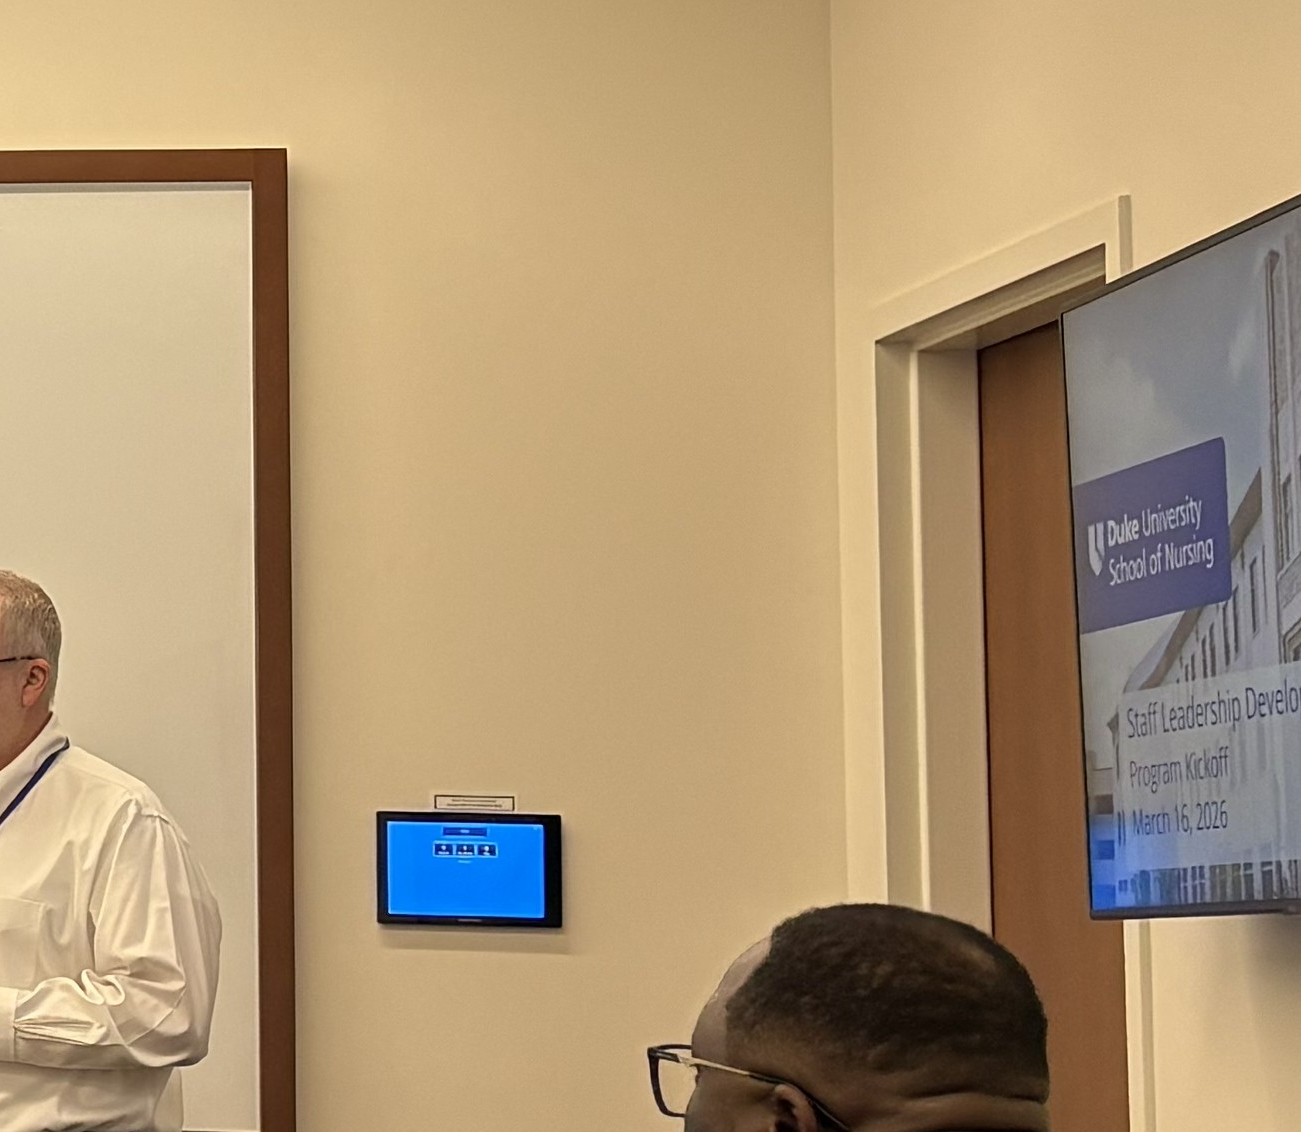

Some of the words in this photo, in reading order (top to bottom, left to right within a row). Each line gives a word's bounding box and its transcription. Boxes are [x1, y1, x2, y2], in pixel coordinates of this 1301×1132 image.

[1107, 513, 1139, 548] Duke
[1141, 494, 1202, 537] University
[1109, 548, 1147, 586] School
[1149, 543, 1162, 575] of
[1164, 534, 1215, 569] Nursing
[1127, 702, 1159, 739] Staff
[1161, 690, 1241, 734] Leadership
[1245, 678, 1301, 720] Develo
[1129, 760, 1183, 794] Program
[1185, 746, 1229, 781] Kickoff
[1132, 807, 1171, 836] March
[1174, 803, 1193, 836] 16,
[1196, 799, 1229, 830] 2026
